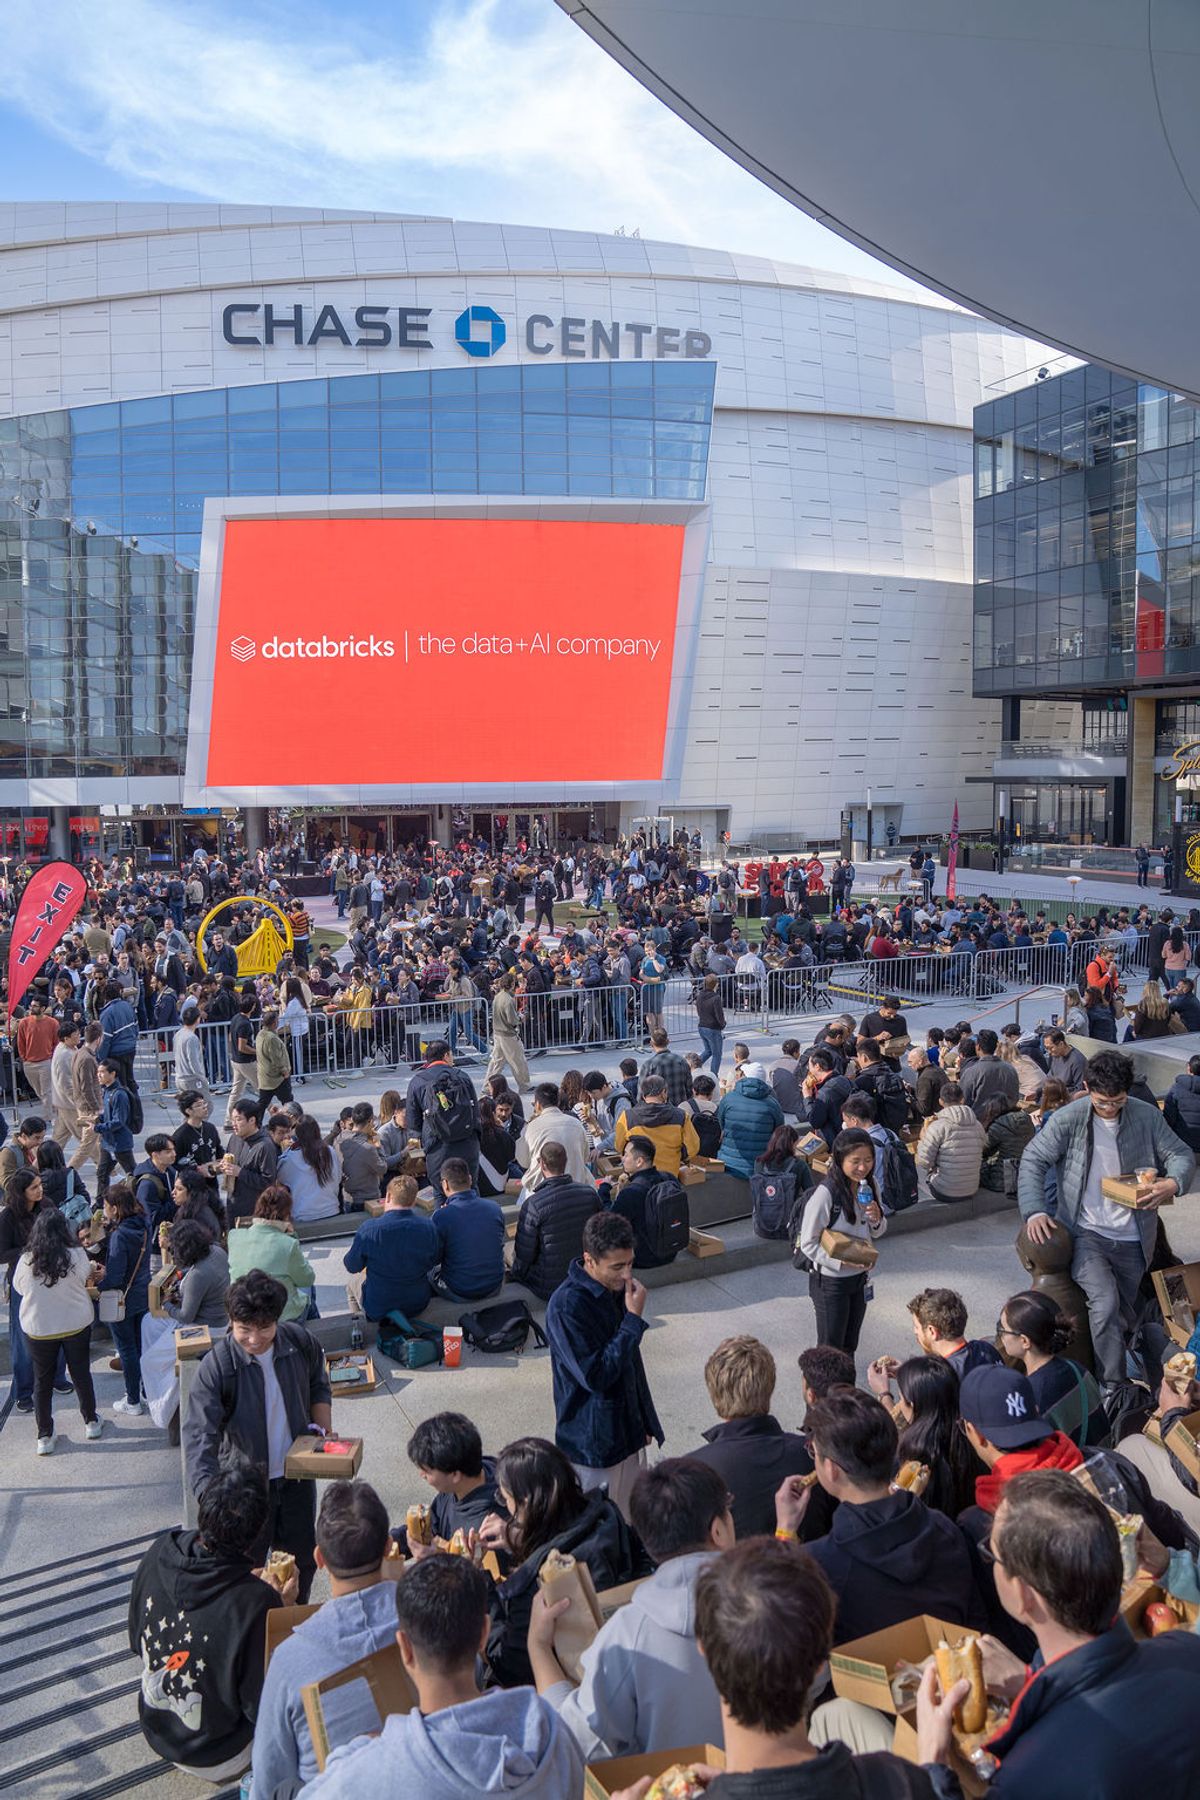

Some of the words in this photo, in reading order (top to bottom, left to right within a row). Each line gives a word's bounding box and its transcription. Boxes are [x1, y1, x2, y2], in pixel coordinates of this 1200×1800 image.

[223, 304, 434, 348] CHASE
[526, 315, 712, 359] CENTER
[262, 635, 394, 657] databricks
[419, 632, 455, 653] the
[462, 632, 549, 654] data+AI
[557, 638, 661, 661] company
[18, 882, 73, 965] EXIT
[1006, 1391, 1027, 1417] NY
